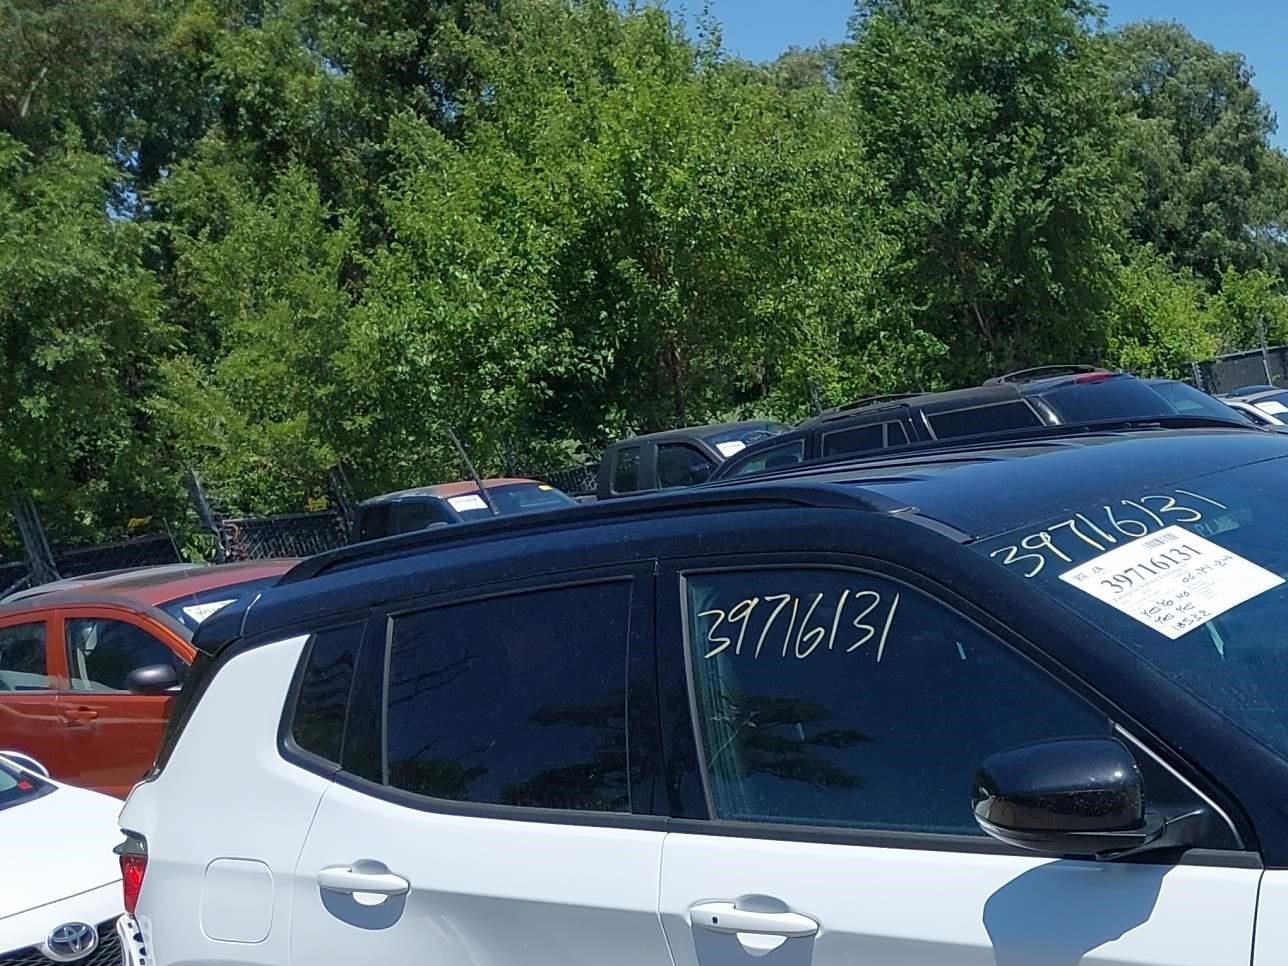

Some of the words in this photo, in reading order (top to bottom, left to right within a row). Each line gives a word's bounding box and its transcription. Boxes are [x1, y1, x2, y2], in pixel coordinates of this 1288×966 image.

[990, 489, 1227, 578] 39716131
[1100, 544, 1204, 594] 39716131
[697, 588, 900, 663] 39716131
